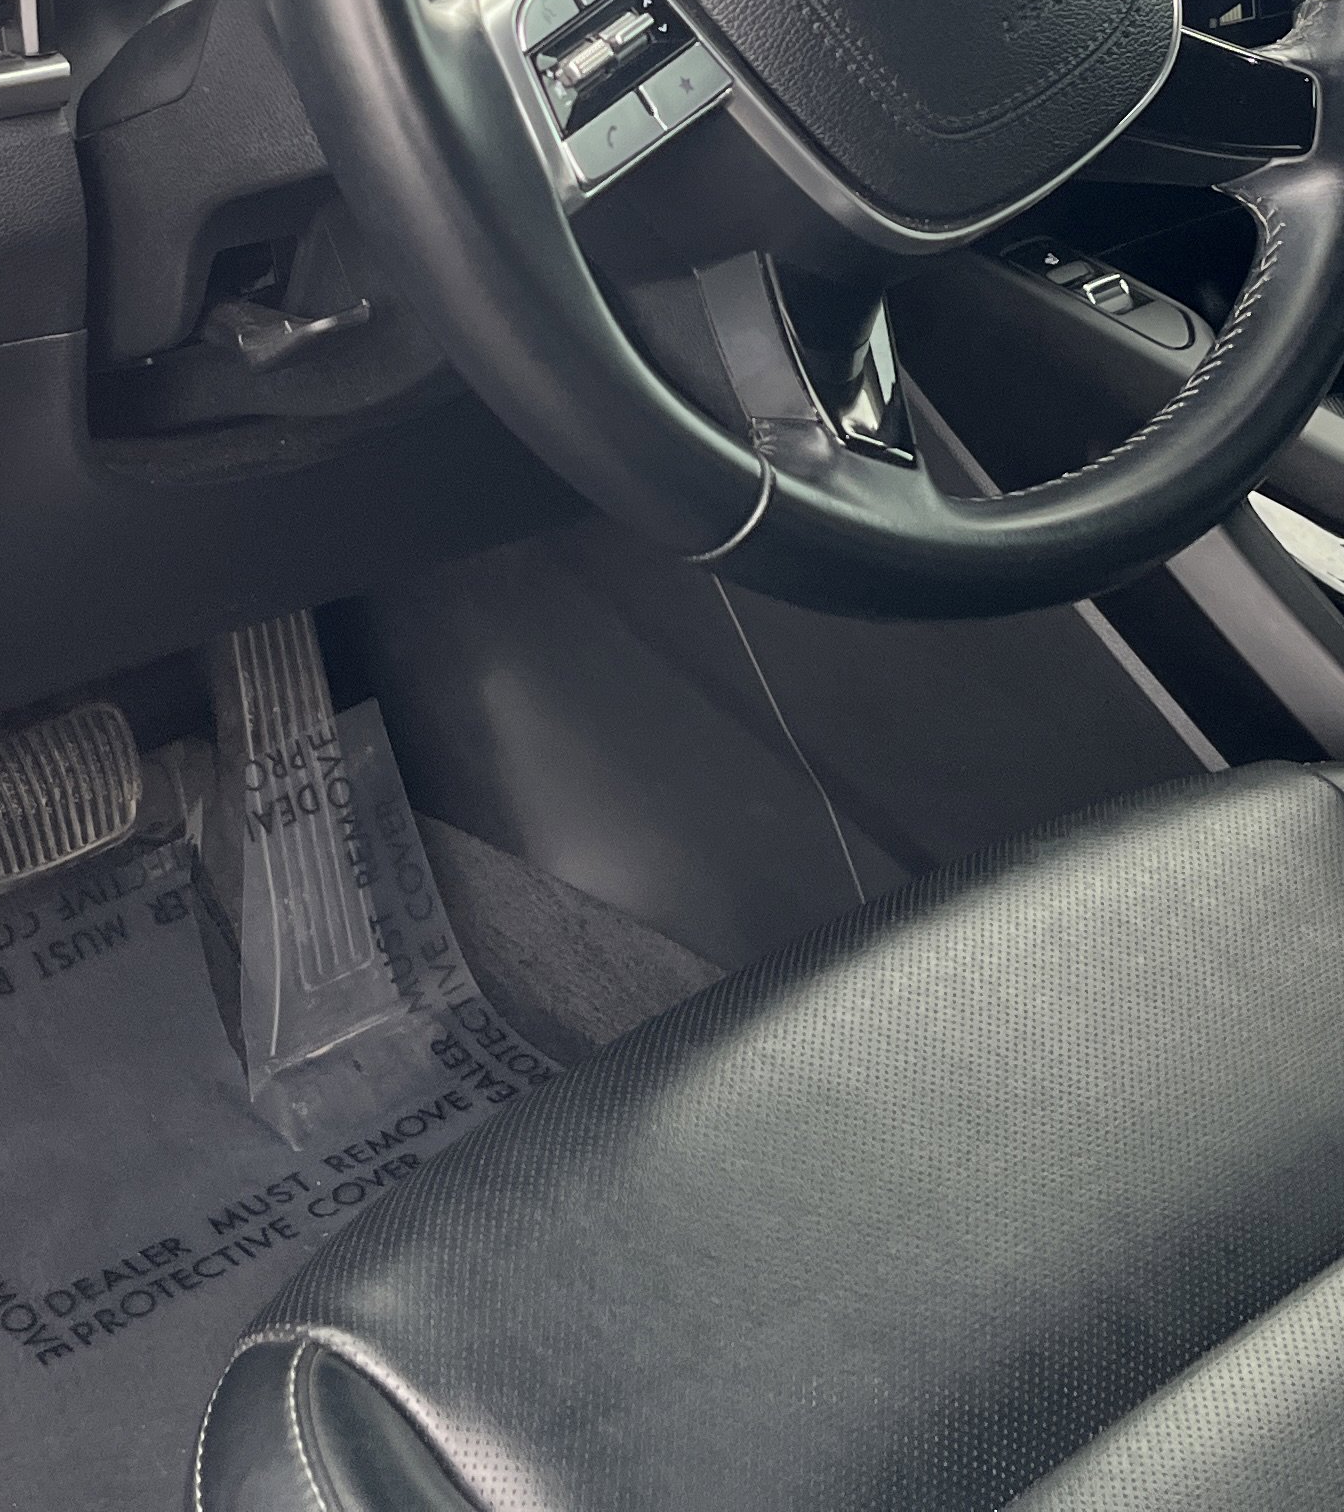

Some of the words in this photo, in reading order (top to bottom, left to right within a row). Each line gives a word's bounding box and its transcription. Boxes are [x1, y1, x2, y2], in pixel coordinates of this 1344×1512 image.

[43, 1238, 192, 1318] DEALER
[206, 1170, 310, 1236] MUST
[322, 1090, 473, 1175] REMOVE
[68, 1216, 300, 1346] PROTECTIVE
[307, 1152, 422, 1219] COVER
